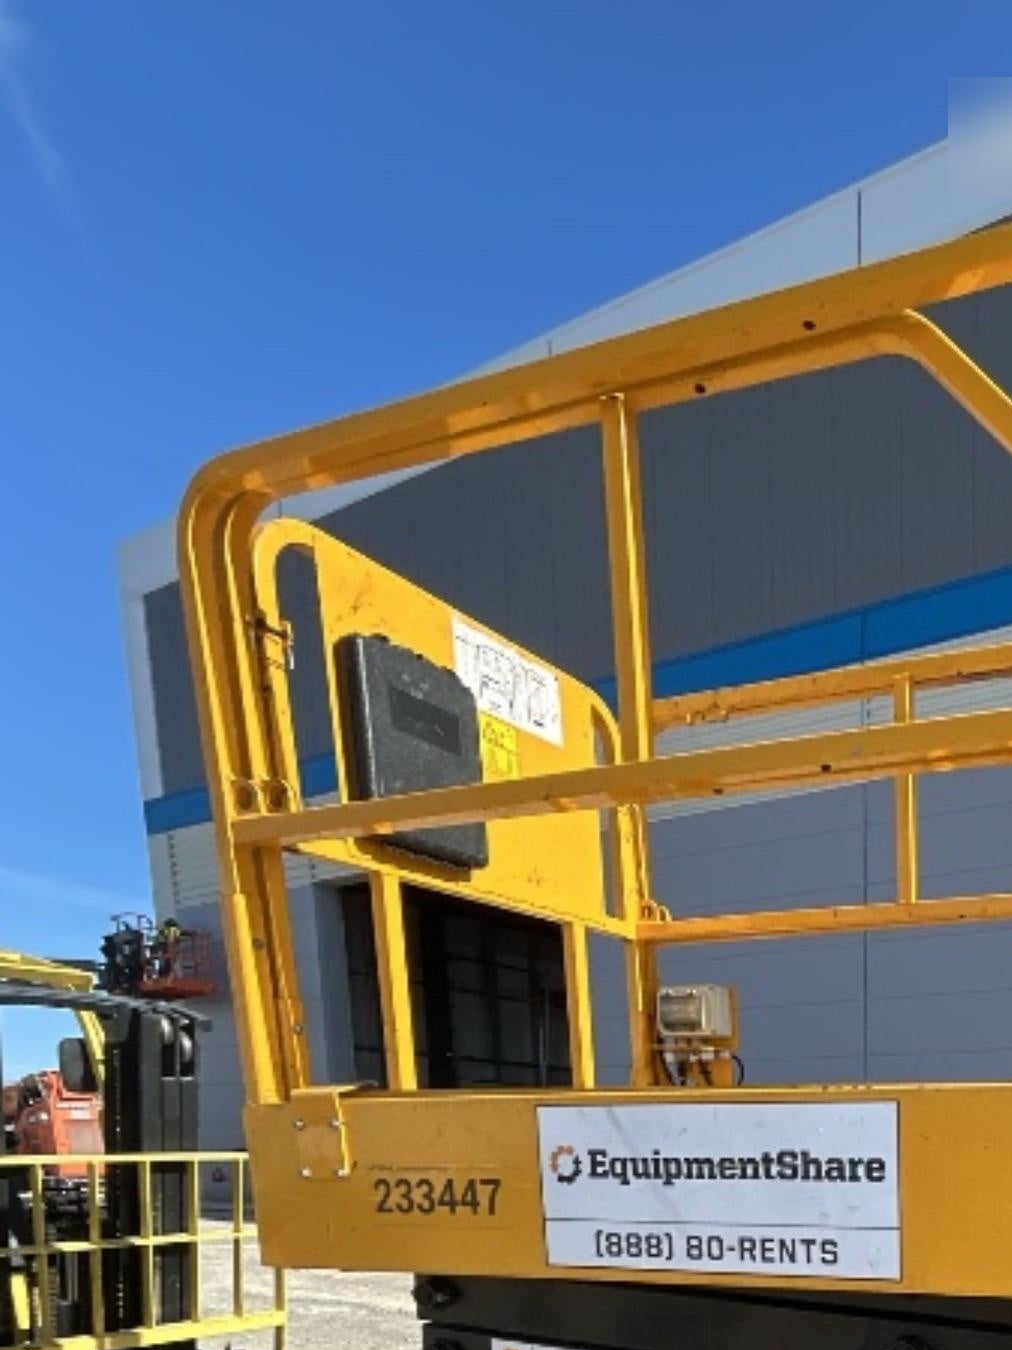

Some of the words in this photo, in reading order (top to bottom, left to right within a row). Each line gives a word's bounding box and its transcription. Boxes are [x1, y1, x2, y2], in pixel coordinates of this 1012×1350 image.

[587, 1149, 886, 1187] EquipmentShare
[373, 1178, 502, 1216] 233447
[595, 1230, 674, 1260] (888)
[686, 1235, 840, 1265] 80-RENTS
